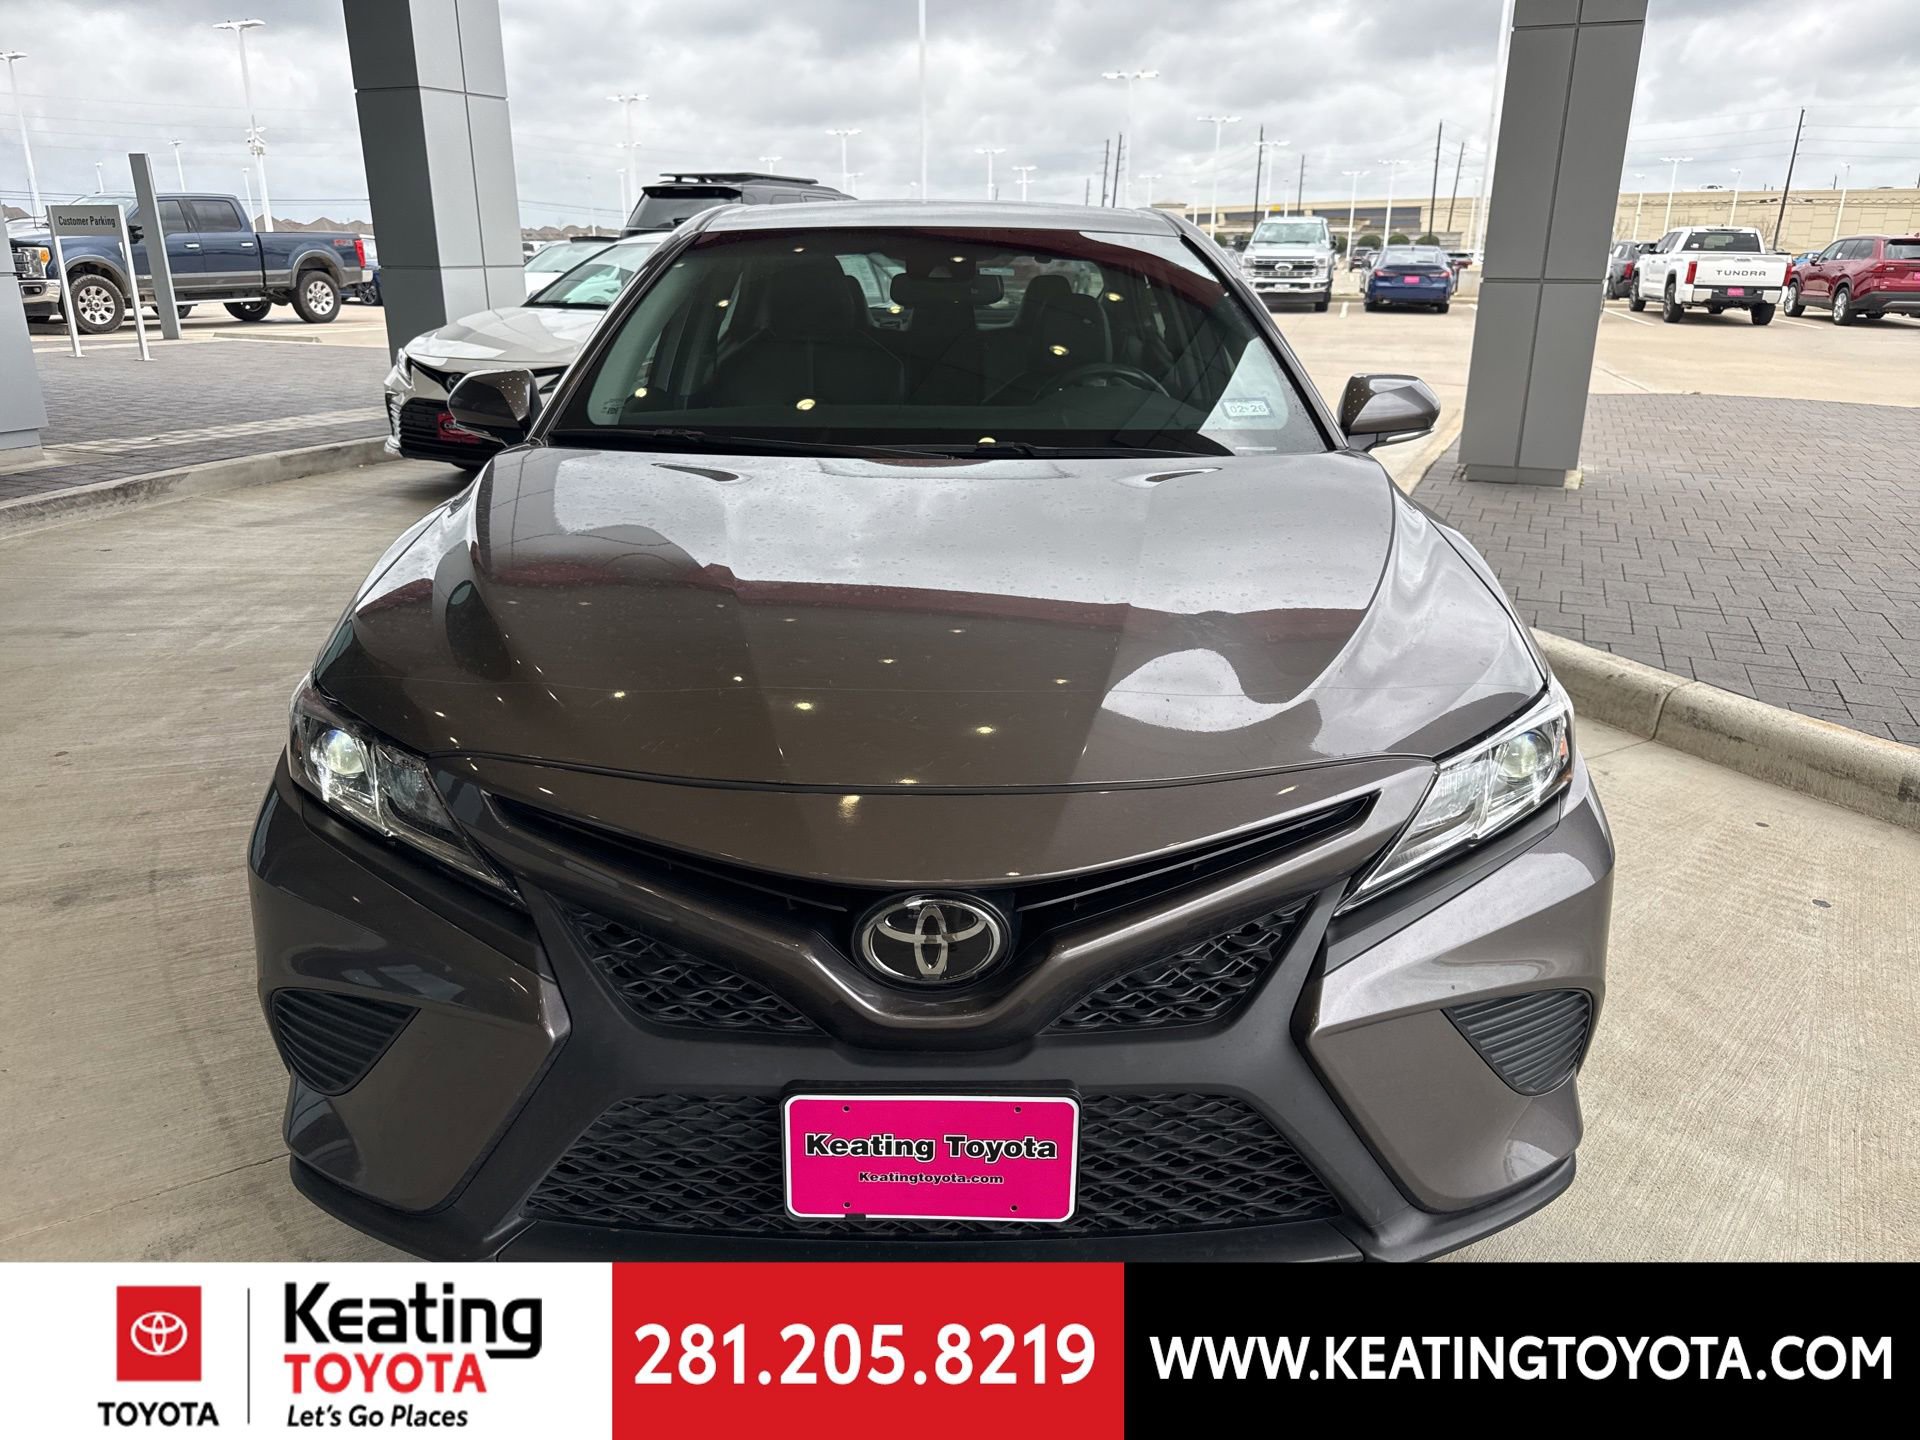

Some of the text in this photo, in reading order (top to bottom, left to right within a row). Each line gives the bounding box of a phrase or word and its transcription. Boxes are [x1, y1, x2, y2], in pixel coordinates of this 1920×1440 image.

[58, 215, 116, 228] Customer Parking
[1715, 269, 1767, 277] TUNDRA
[804, 1132, 1057, 1164] Keating Toyota
[858, 1171, 1004, 1185] Keatingtoyota.com
